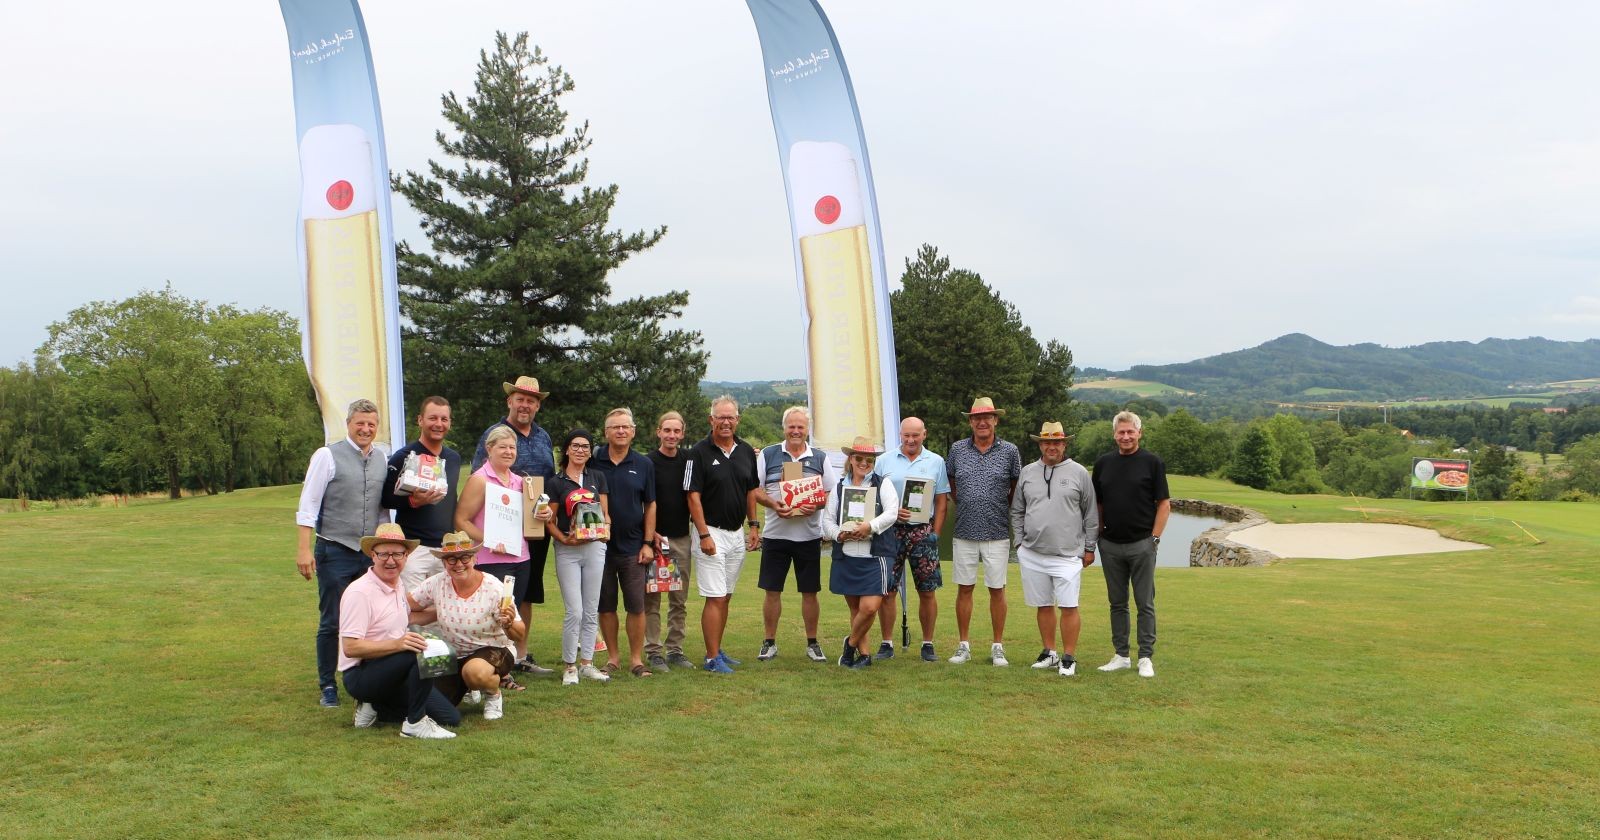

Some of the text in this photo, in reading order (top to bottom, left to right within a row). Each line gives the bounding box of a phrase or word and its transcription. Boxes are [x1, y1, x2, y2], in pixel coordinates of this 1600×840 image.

[783, 477, 820, 507] Stiegl
[808, 495, 825, 504] Bier
[490, 502, 519, 517] TRUMER
[498, 512, 512, 522] PILS
